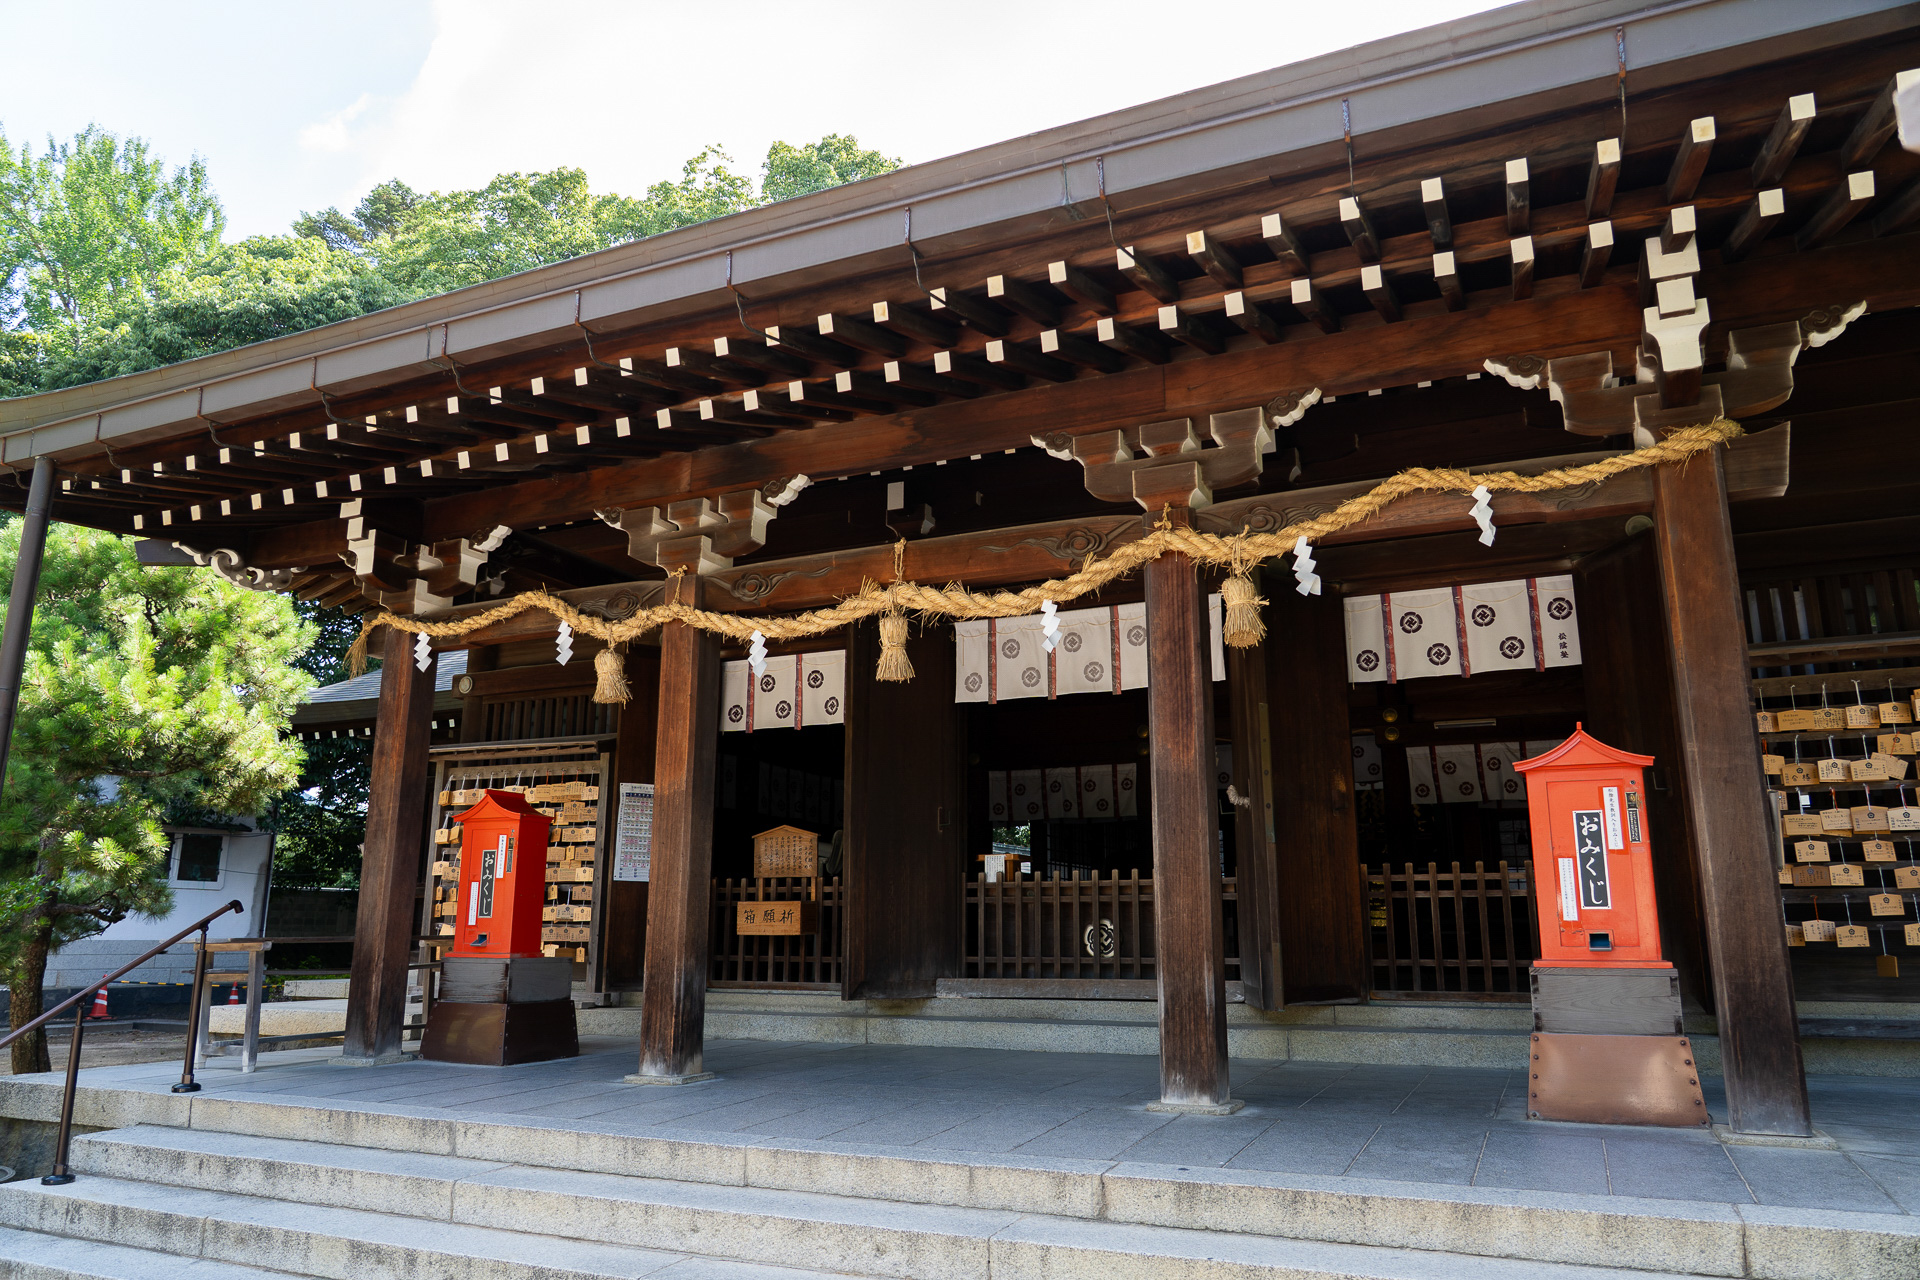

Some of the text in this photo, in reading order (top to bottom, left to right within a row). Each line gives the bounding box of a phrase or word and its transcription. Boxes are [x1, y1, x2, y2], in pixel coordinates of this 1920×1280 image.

[483, 853, 494, 914] おみくじ
[1580, 815, 1604, 904] おみくじ
